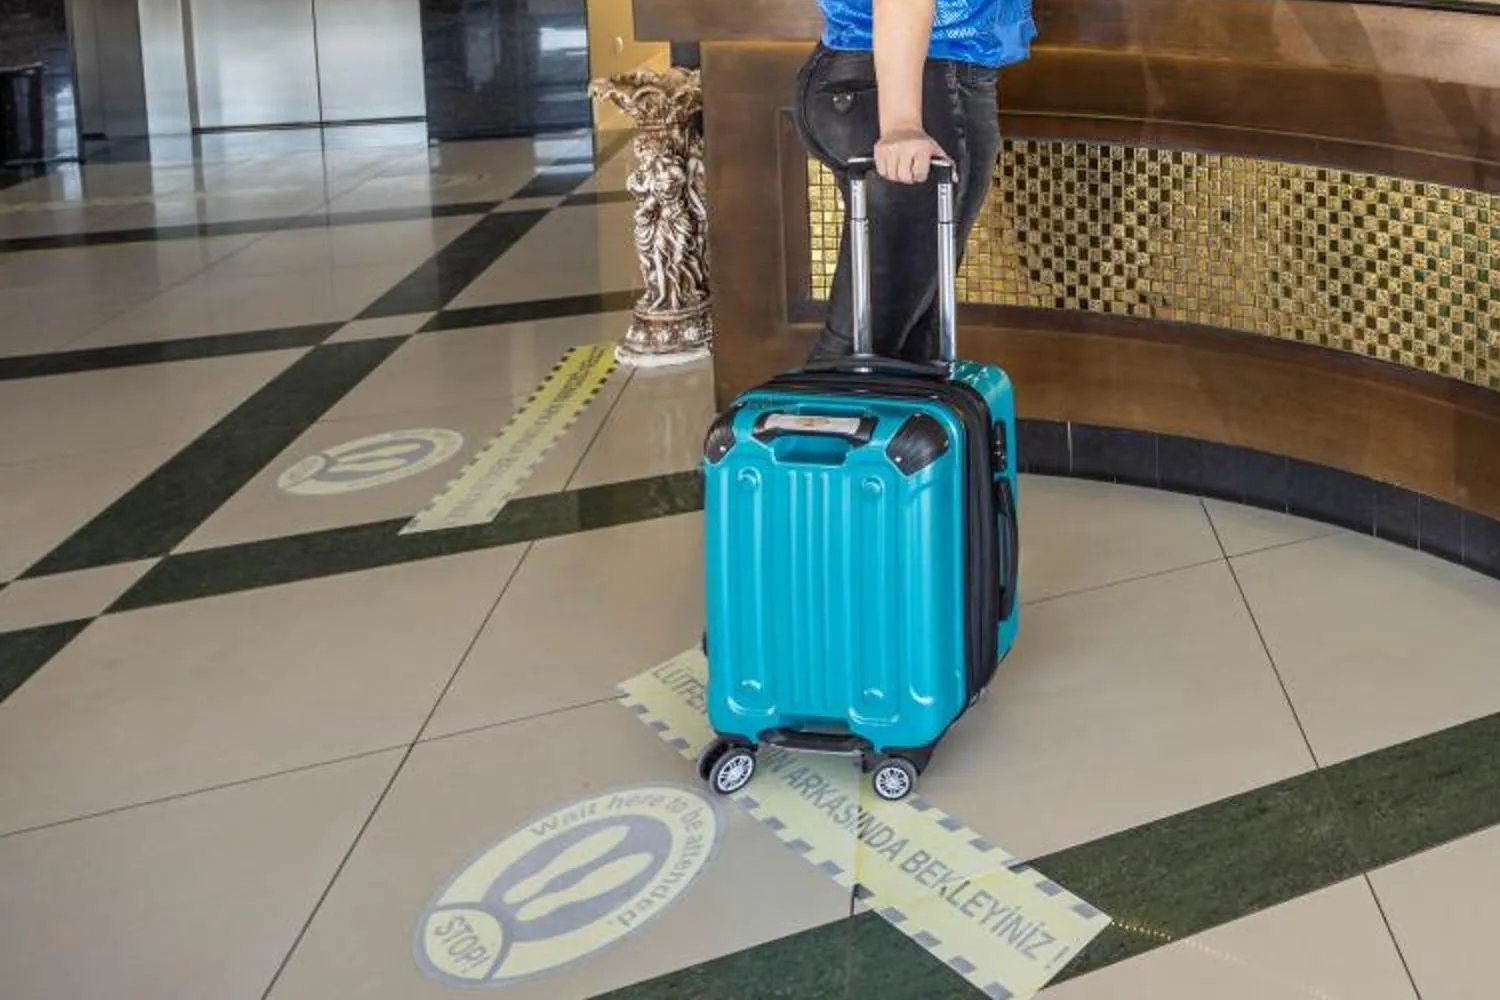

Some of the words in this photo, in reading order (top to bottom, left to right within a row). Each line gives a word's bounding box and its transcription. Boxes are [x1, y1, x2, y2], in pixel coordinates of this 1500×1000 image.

[652, 661, 706, 715] LÜTFE
[530, 802, 597, 837] Wait
[607, 793, 666, 811] here
[664, 797, 689, 815] to
[899, 850, 1056, 960] BEKLEYİNİZ
[434, 915, 491, 973] STOP!
